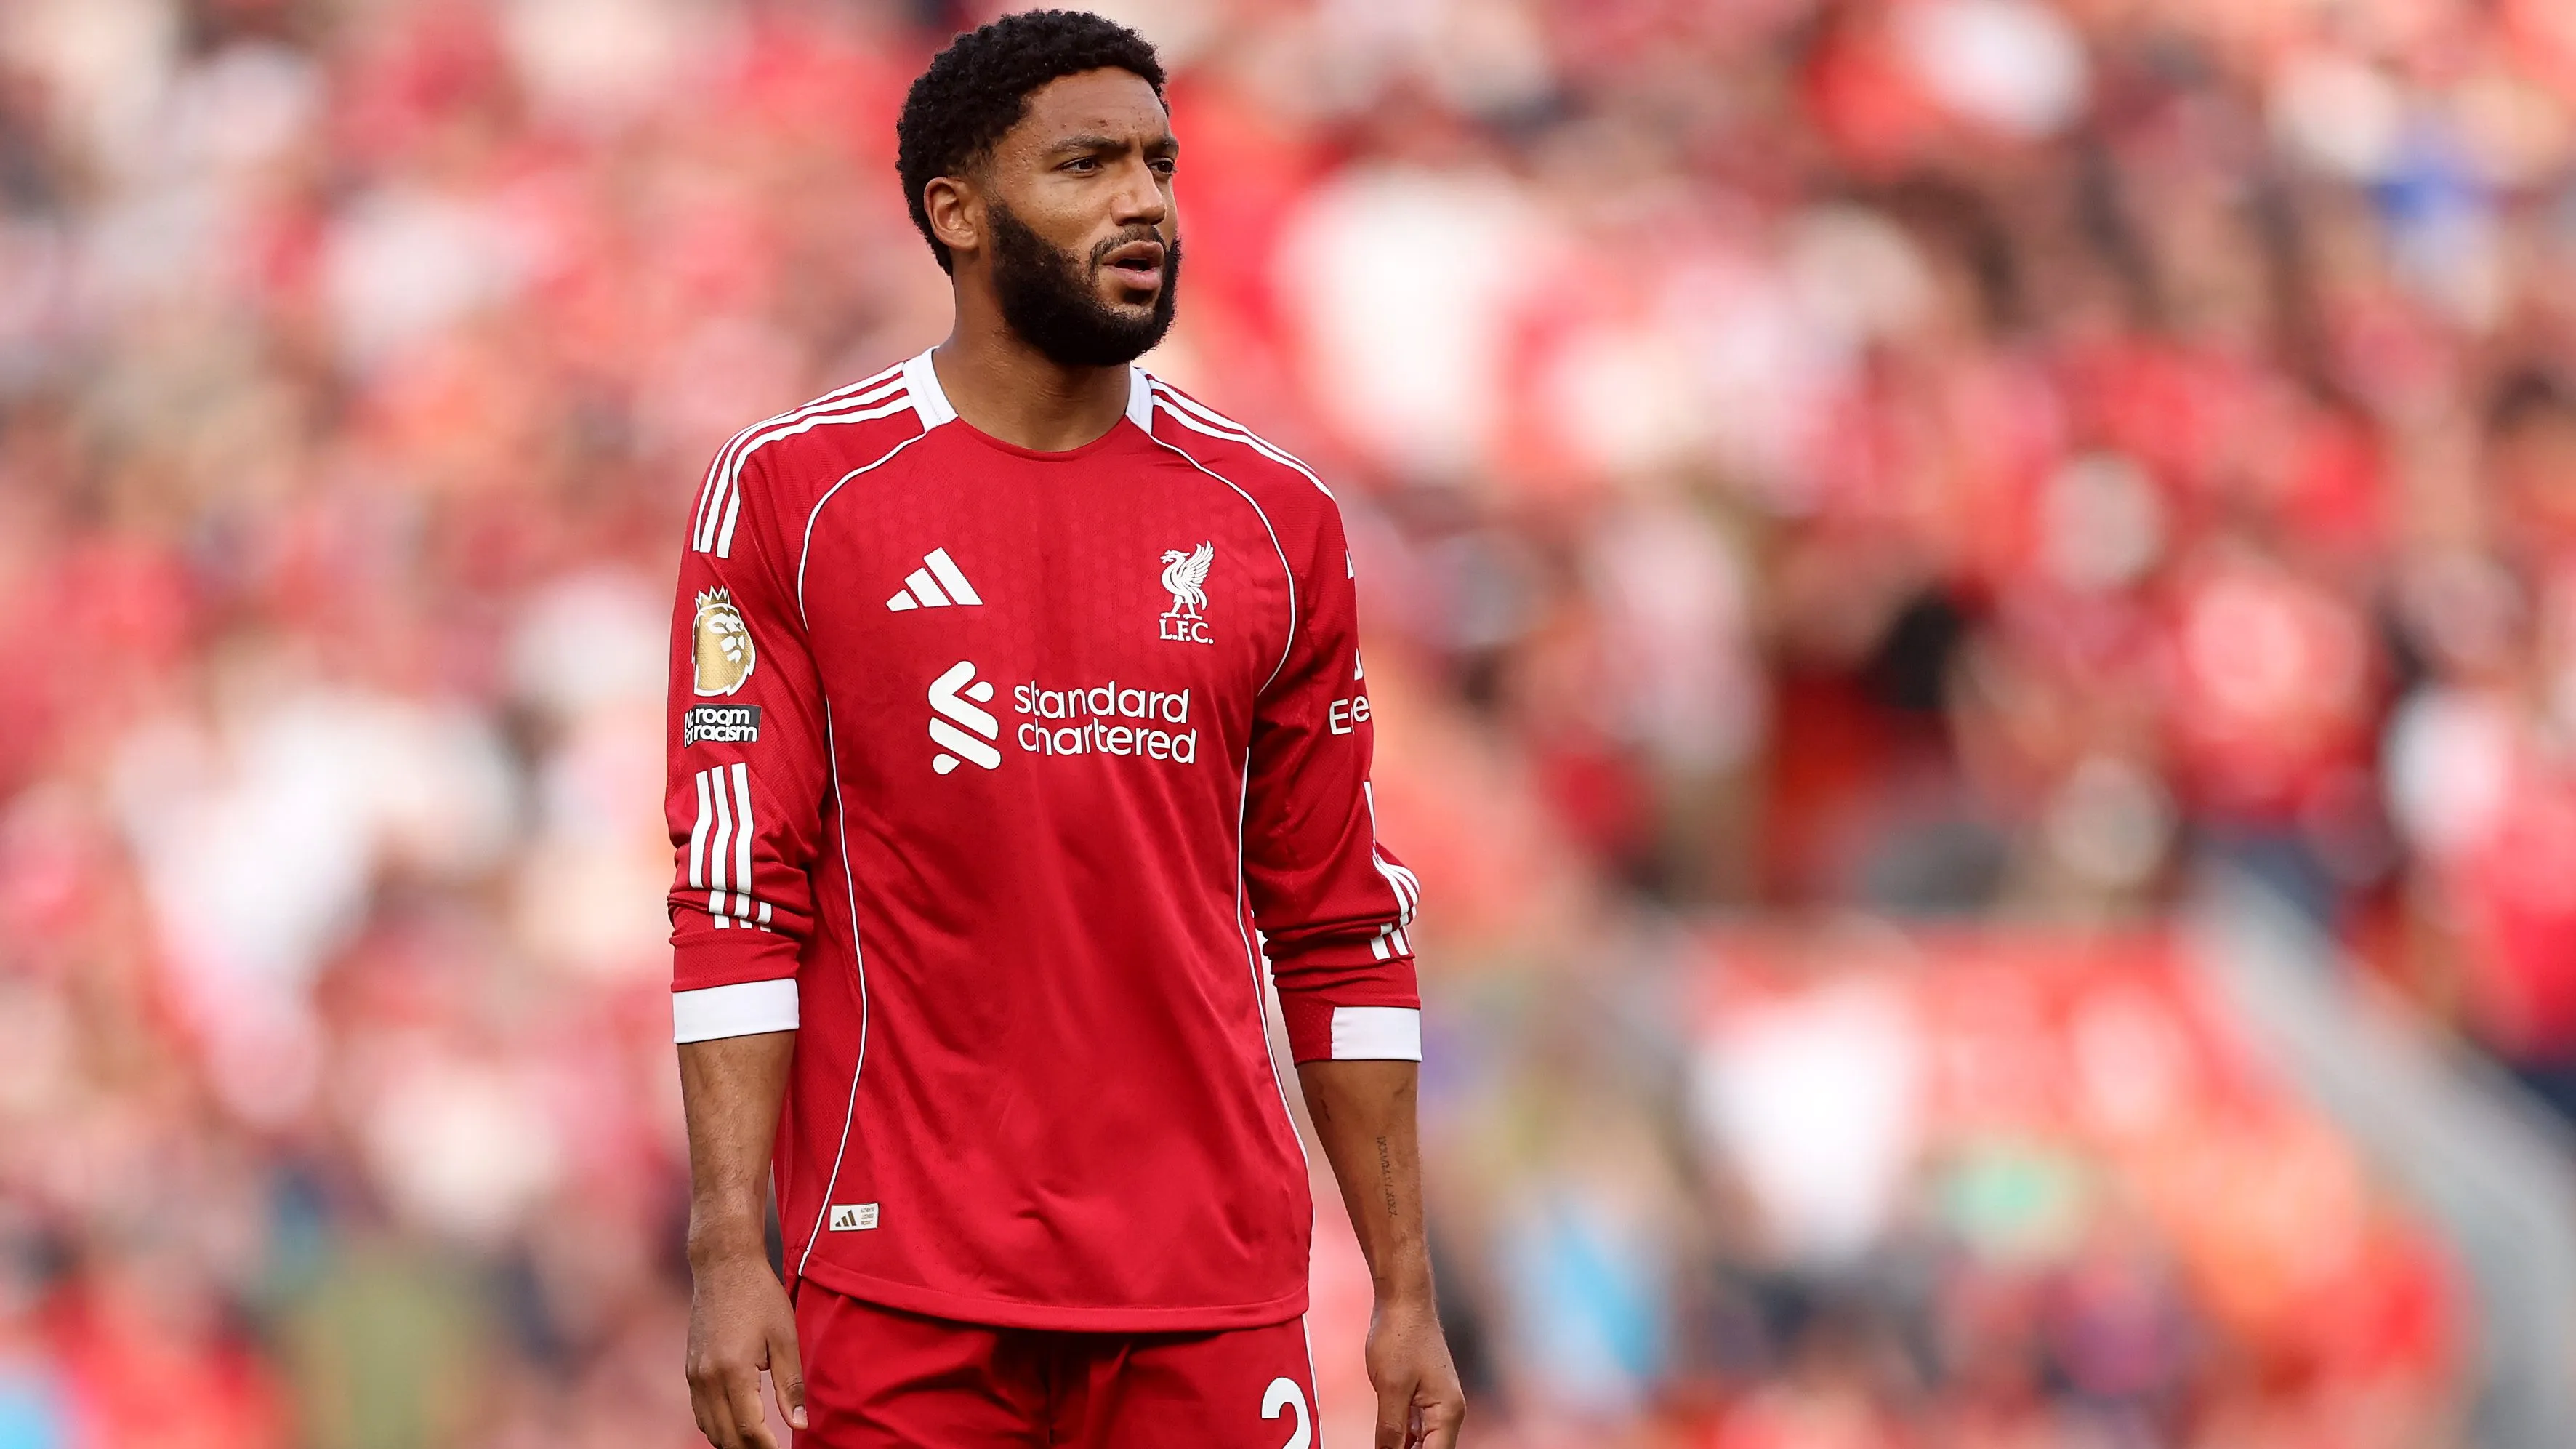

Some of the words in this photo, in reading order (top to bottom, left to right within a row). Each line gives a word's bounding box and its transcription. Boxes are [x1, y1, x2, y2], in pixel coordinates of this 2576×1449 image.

[1159, 619, 1214, 644] L.F.C.
[695, 708, 750, 726] room
[1013, 680, 1190, 724] standard
[693, 724, 758, 742] racism
[1018, 717, 1196, 764] chartered
[1260, 1376, 1312, 1449] 2
